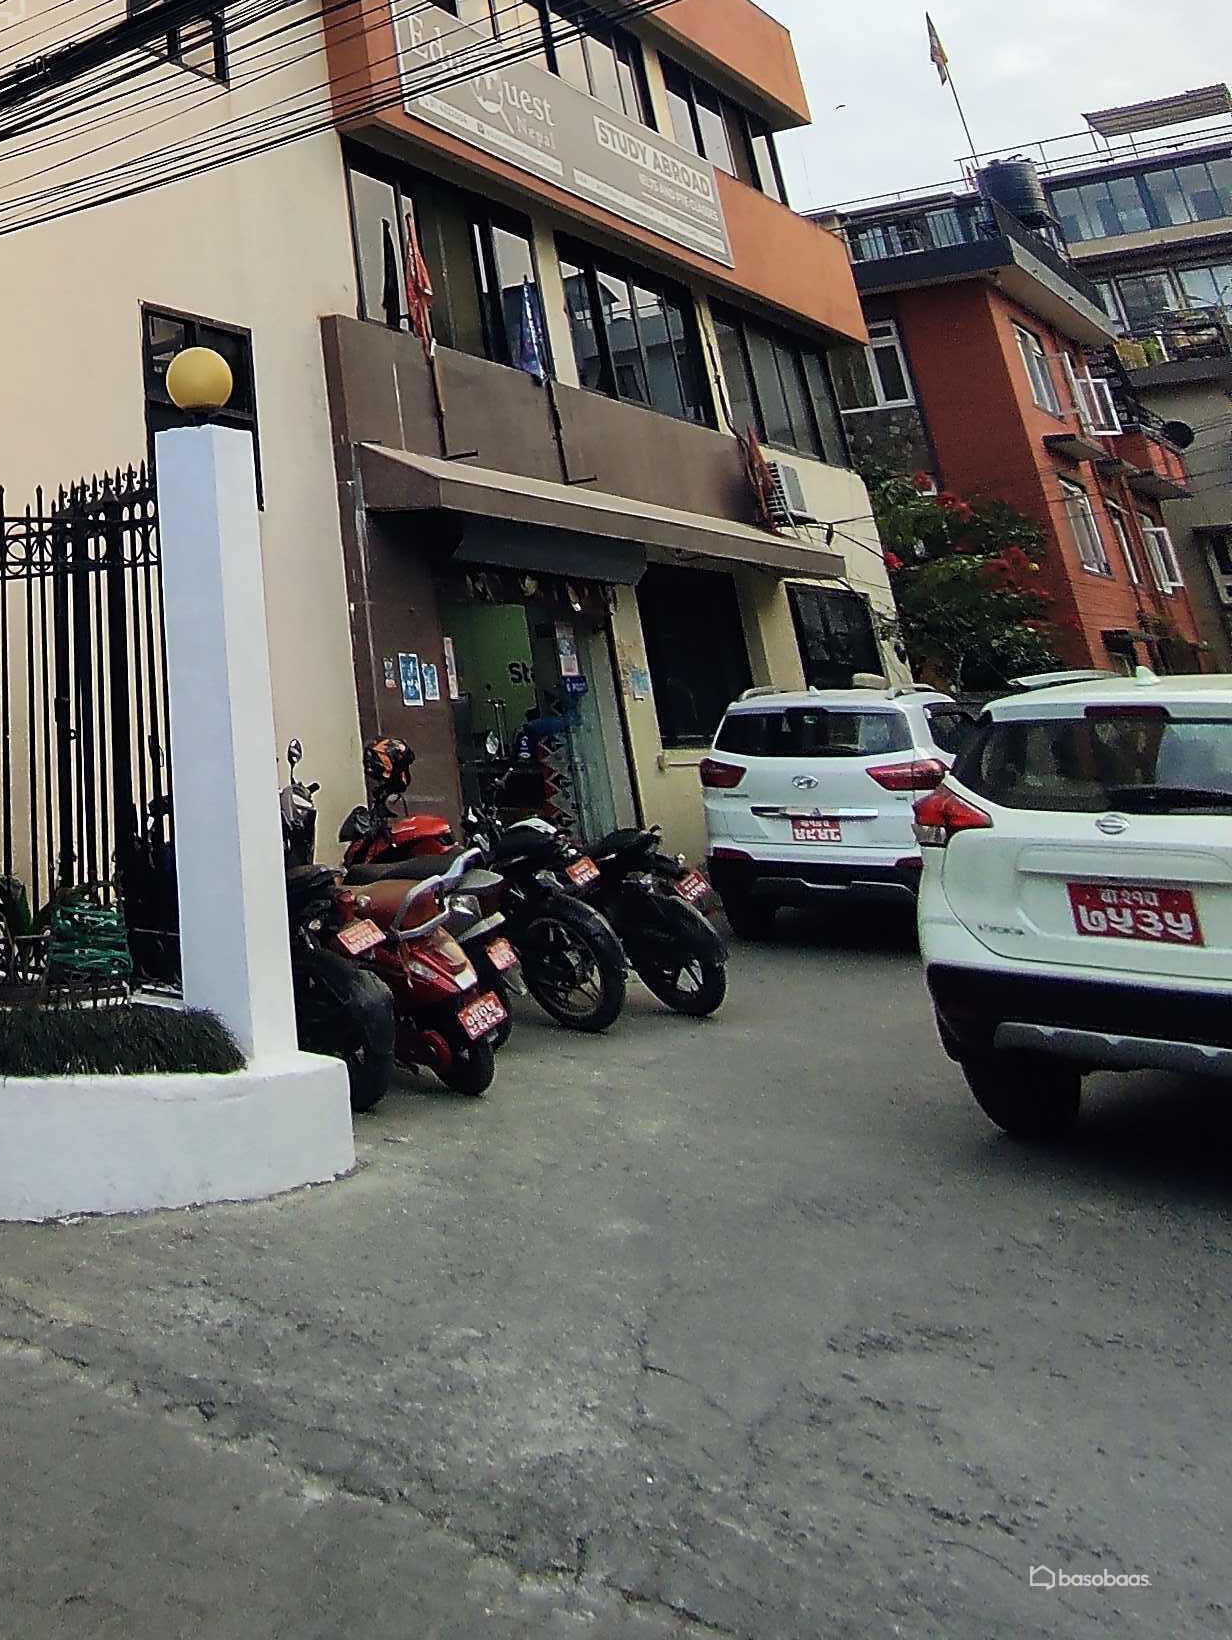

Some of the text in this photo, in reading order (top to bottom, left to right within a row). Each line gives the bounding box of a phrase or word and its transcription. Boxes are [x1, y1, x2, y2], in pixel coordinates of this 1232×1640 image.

[516, 114, 557, 150] Nepal
[599, 121, 648, 164] STUDY
[652, 151, 711, 198] ABROAD
